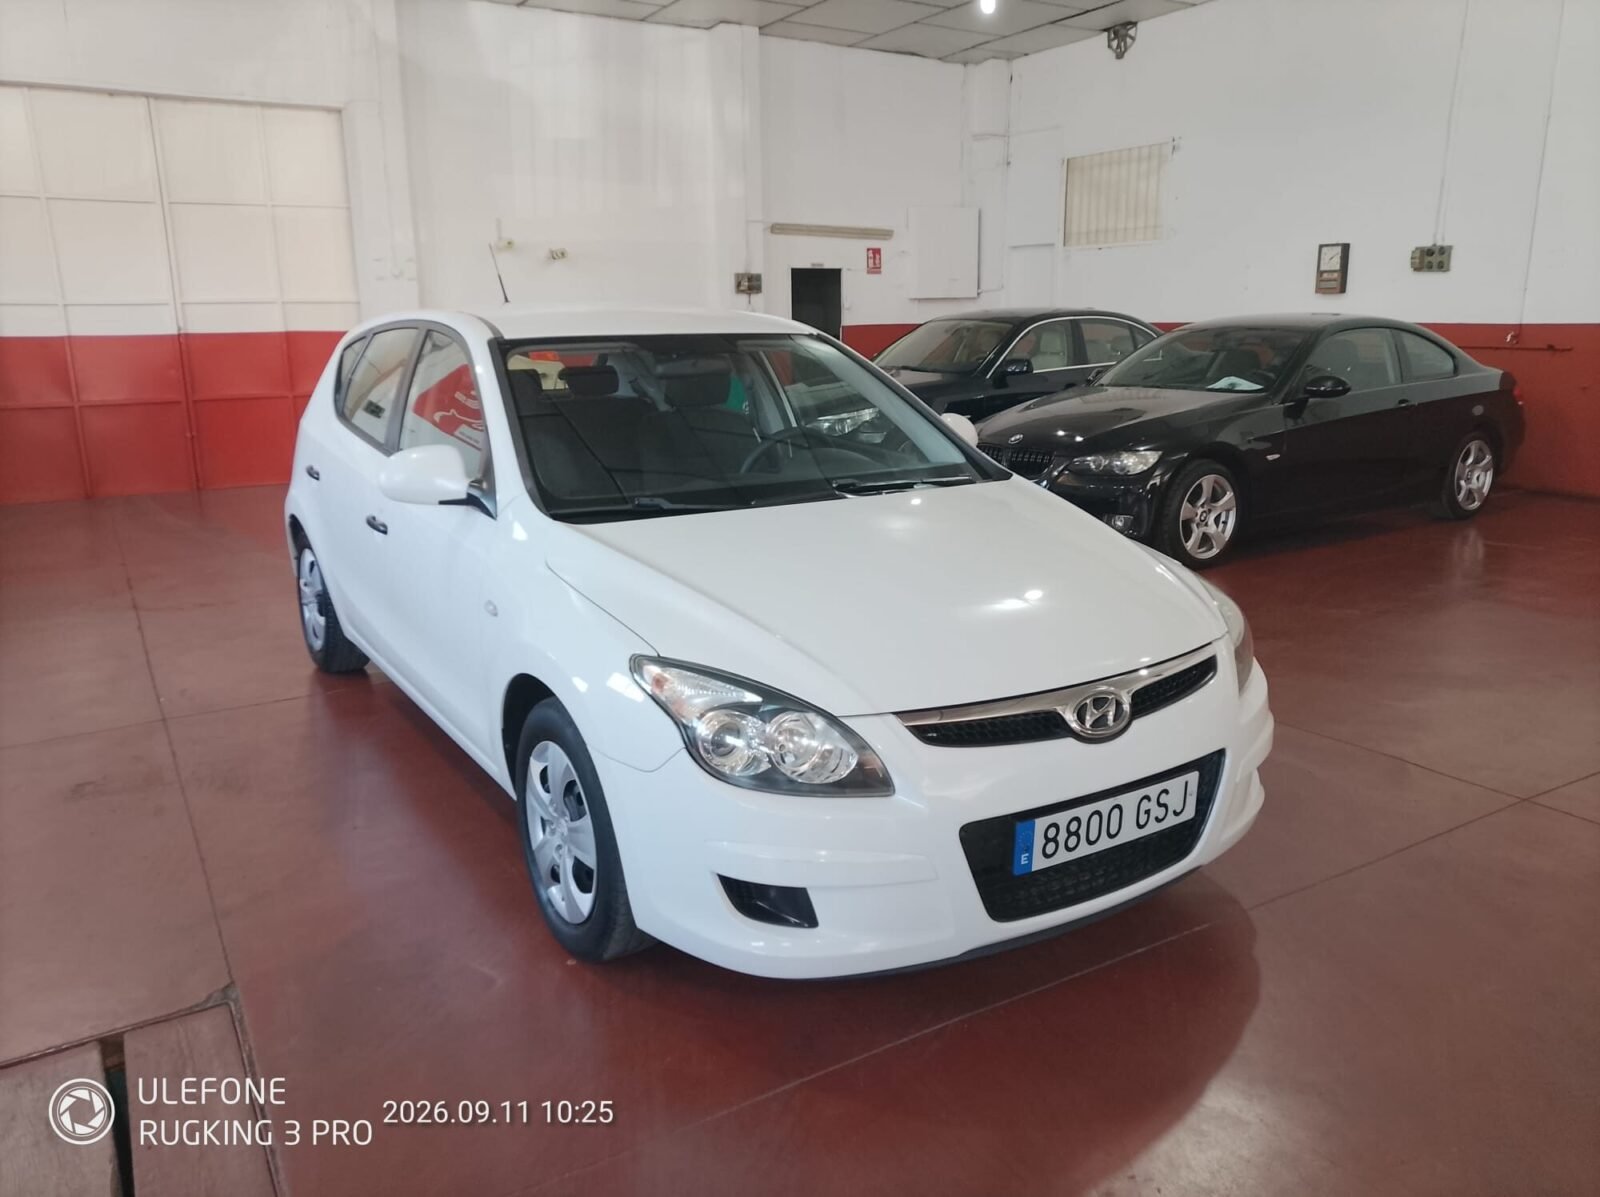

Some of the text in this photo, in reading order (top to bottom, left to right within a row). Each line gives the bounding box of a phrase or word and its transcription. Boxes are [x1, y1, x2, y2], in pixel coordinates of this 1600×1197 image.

[1041, 780, 1189, 860] 8800 GSJ
[1020, 852, 1030, 865] E
